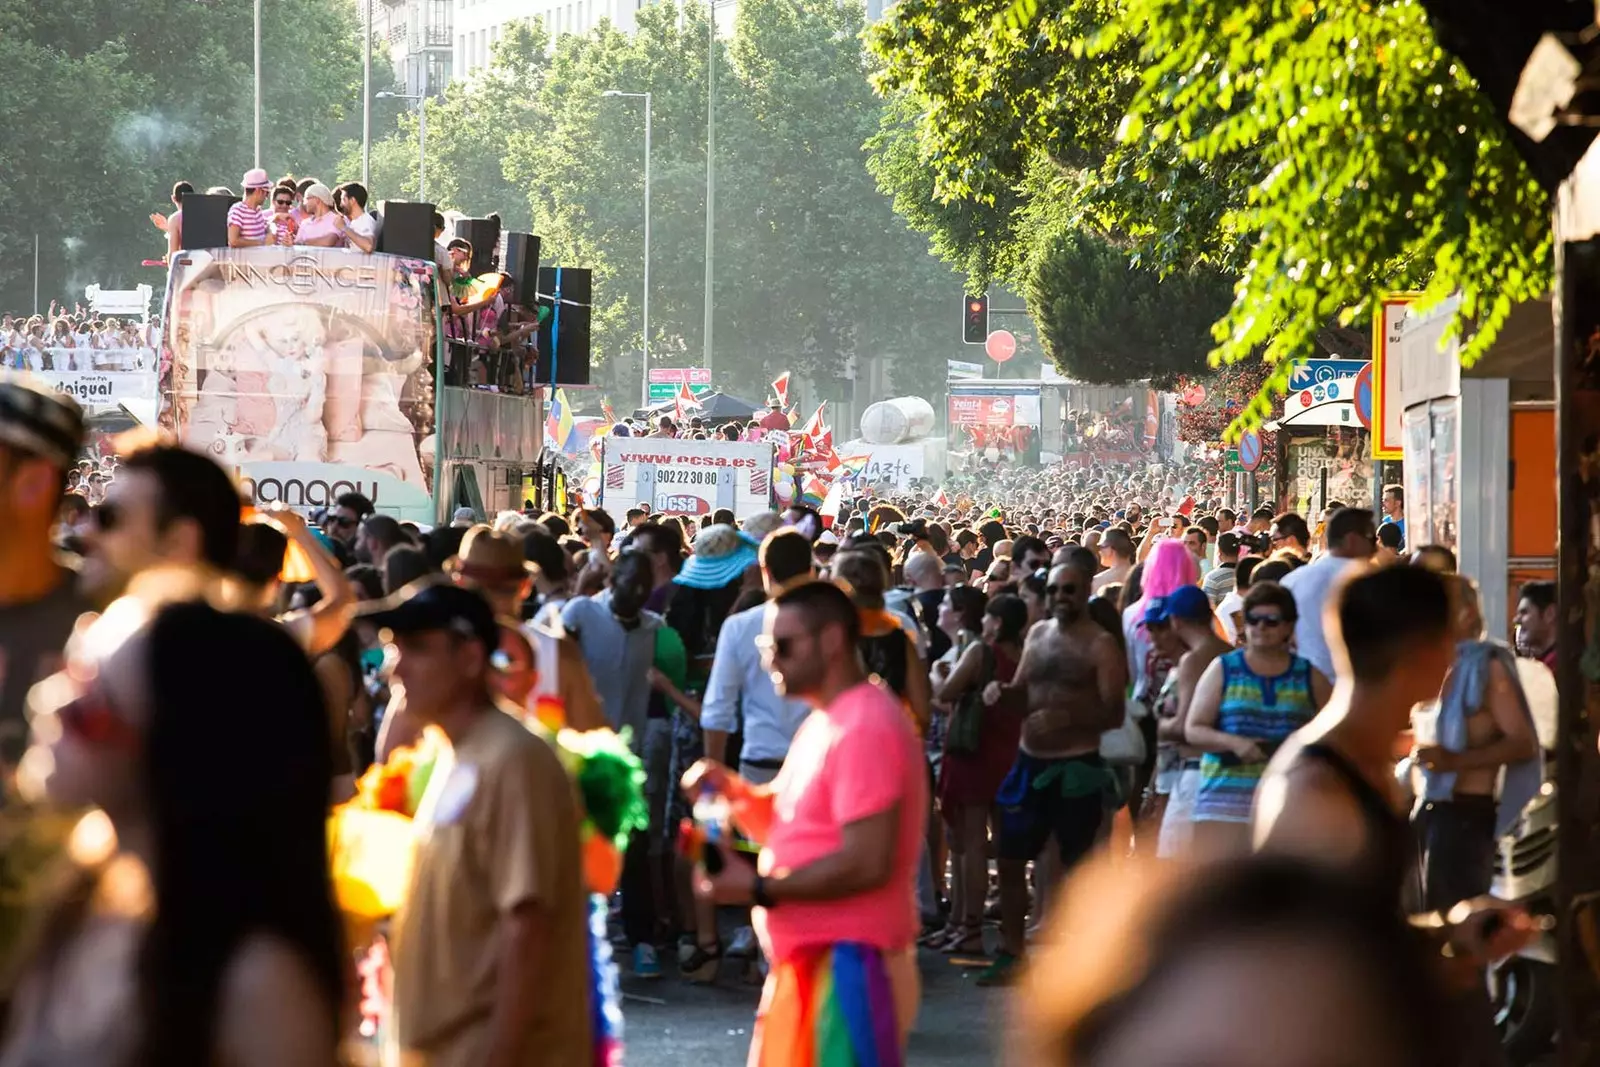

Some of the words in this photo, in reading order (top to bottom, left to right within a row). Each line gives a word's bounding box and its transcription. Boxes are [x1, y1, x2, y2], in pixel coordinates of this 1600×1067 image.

[1297, 446, 1327, 457] UNA
[657, 470, 675, 483] 902
[677, 471, 689, 484] 22
[690, 471, 703, 484] 30
[704, 472, 717, 485] 80
[1320, 489, 1370, 501] LANCO
[656, 493, 698, 512] Ocsa
